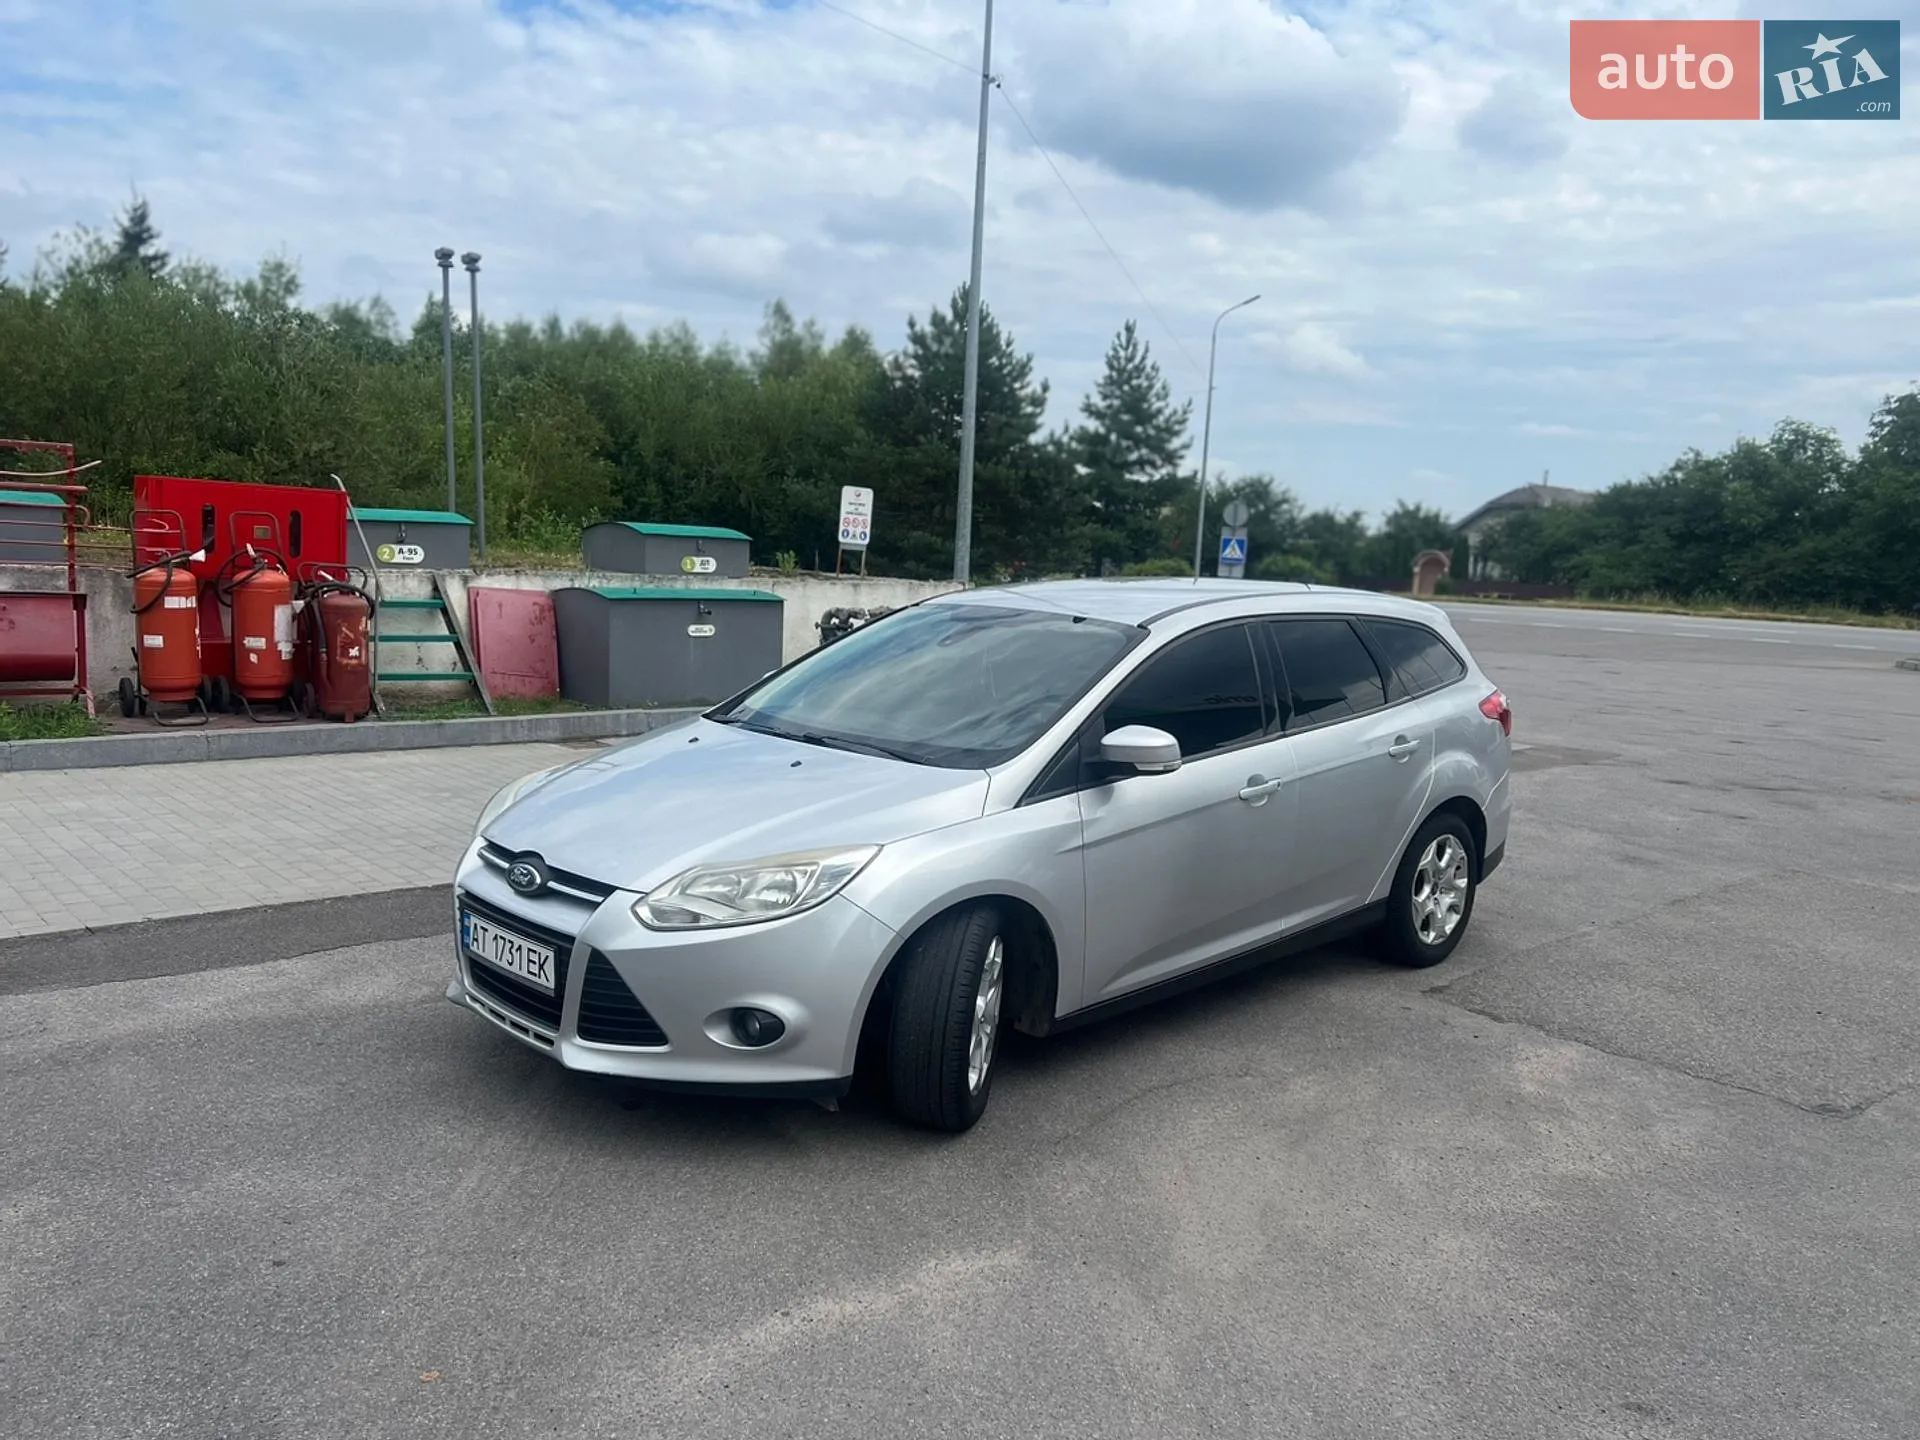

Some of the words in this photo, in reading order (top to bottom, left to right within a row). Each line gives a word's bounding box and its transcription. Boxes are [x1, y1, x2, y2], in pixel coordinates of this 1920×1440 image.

[471, 923, 489, 953] AT
[492, 933, 523, 971] 1731
[526, 946, 550, 983] EK
